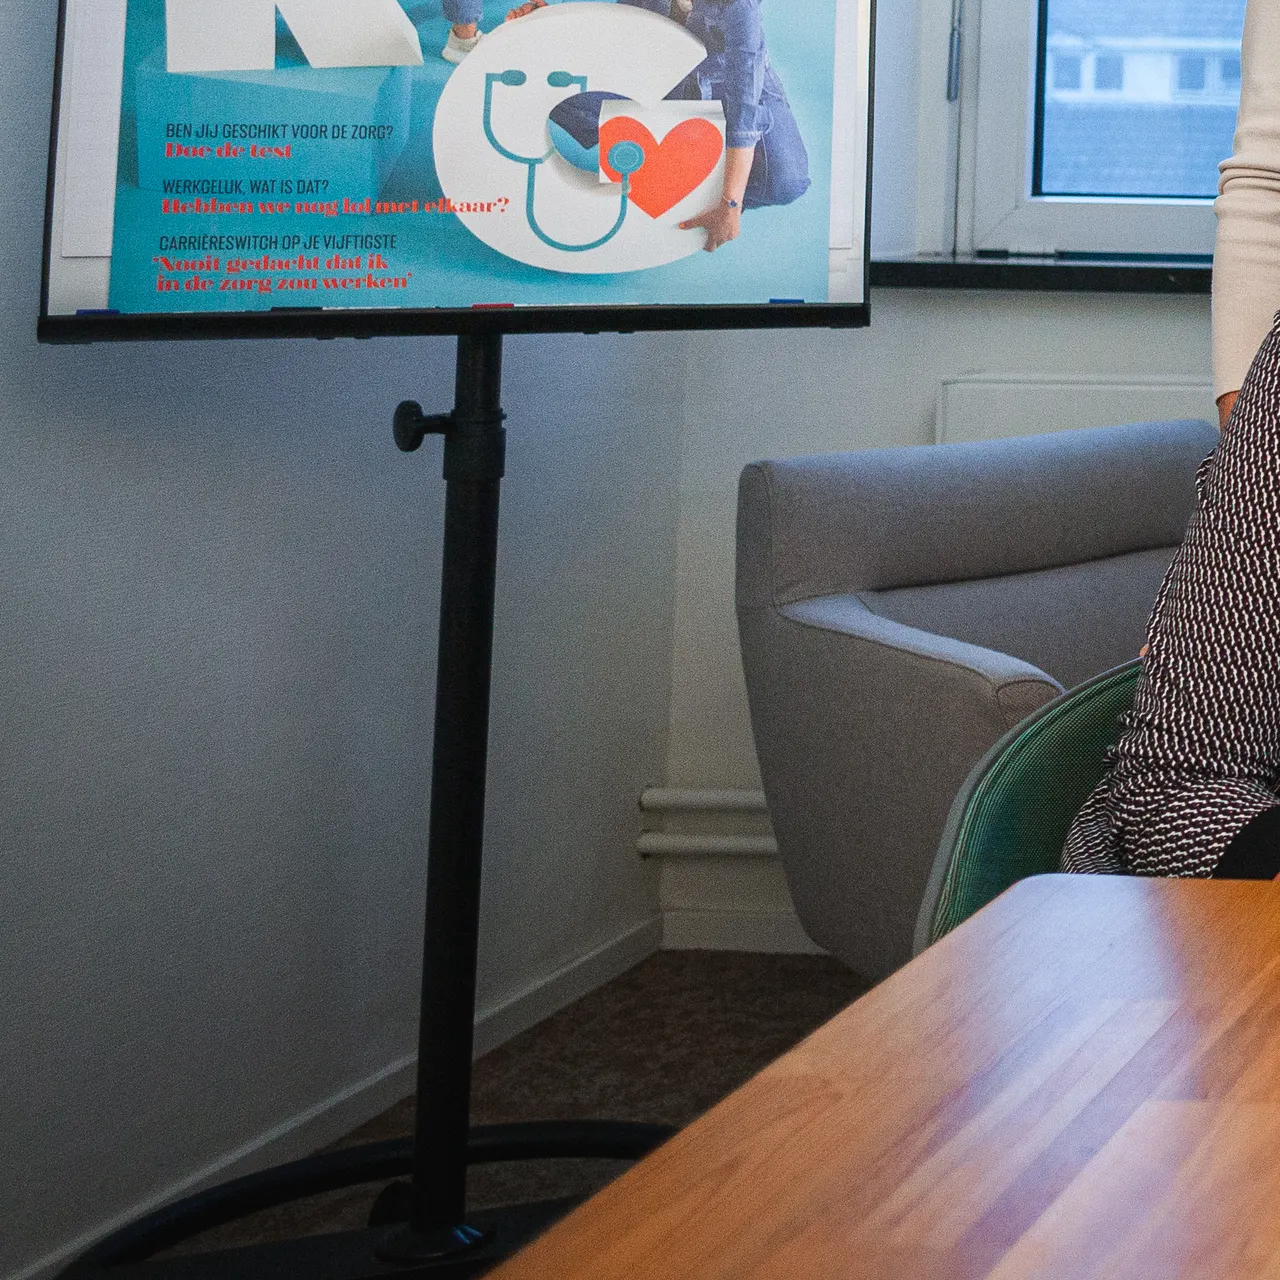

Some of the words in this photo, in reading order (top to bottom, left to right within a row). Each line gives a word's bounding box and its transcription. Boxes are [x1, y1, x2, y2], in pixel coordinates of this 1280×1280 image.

[165, 123, 192, 138] BEN
[195, 124, 218, 139] JIJ
[222, 124, 287, 139] GESCHIKT
[290, 124, 328, 139] VOOR
[331, 124, 347, 139] DE
[351, 125, 394, 140] ZORG?
[164, 142, 211, 158] Doe
[216, 142, 244, 158] de
[250, 144, 291, 158] test
[249, 179, 277, 194] WAT
[280, 179, 293, 194] IS
[298, 179, 329, 194] DAT?
[162, 197, 253, 214] Hebben
[258, 202, 290, 214] we
[295, 202, 338, 217] nog
[343, 197, 371, 214] lol
[375, 200, 419, 214] met
[424, 197, 510, 214] elkaar?
[282, 235, 300, 250] OP
[303, 235, 320, 250] JE
[323, 234, 398, 250] VIJFTIGSTE
[226, 254, 319, 274] gedacht
[325, 254, 362, 271] dat
[367, 253, 388, 270] ik
[156, 275, 179, 292] in
[184, 275, 214, 291] de
[219, 276, 272, 294] zorg
[277, 277, 317, 290] zou
